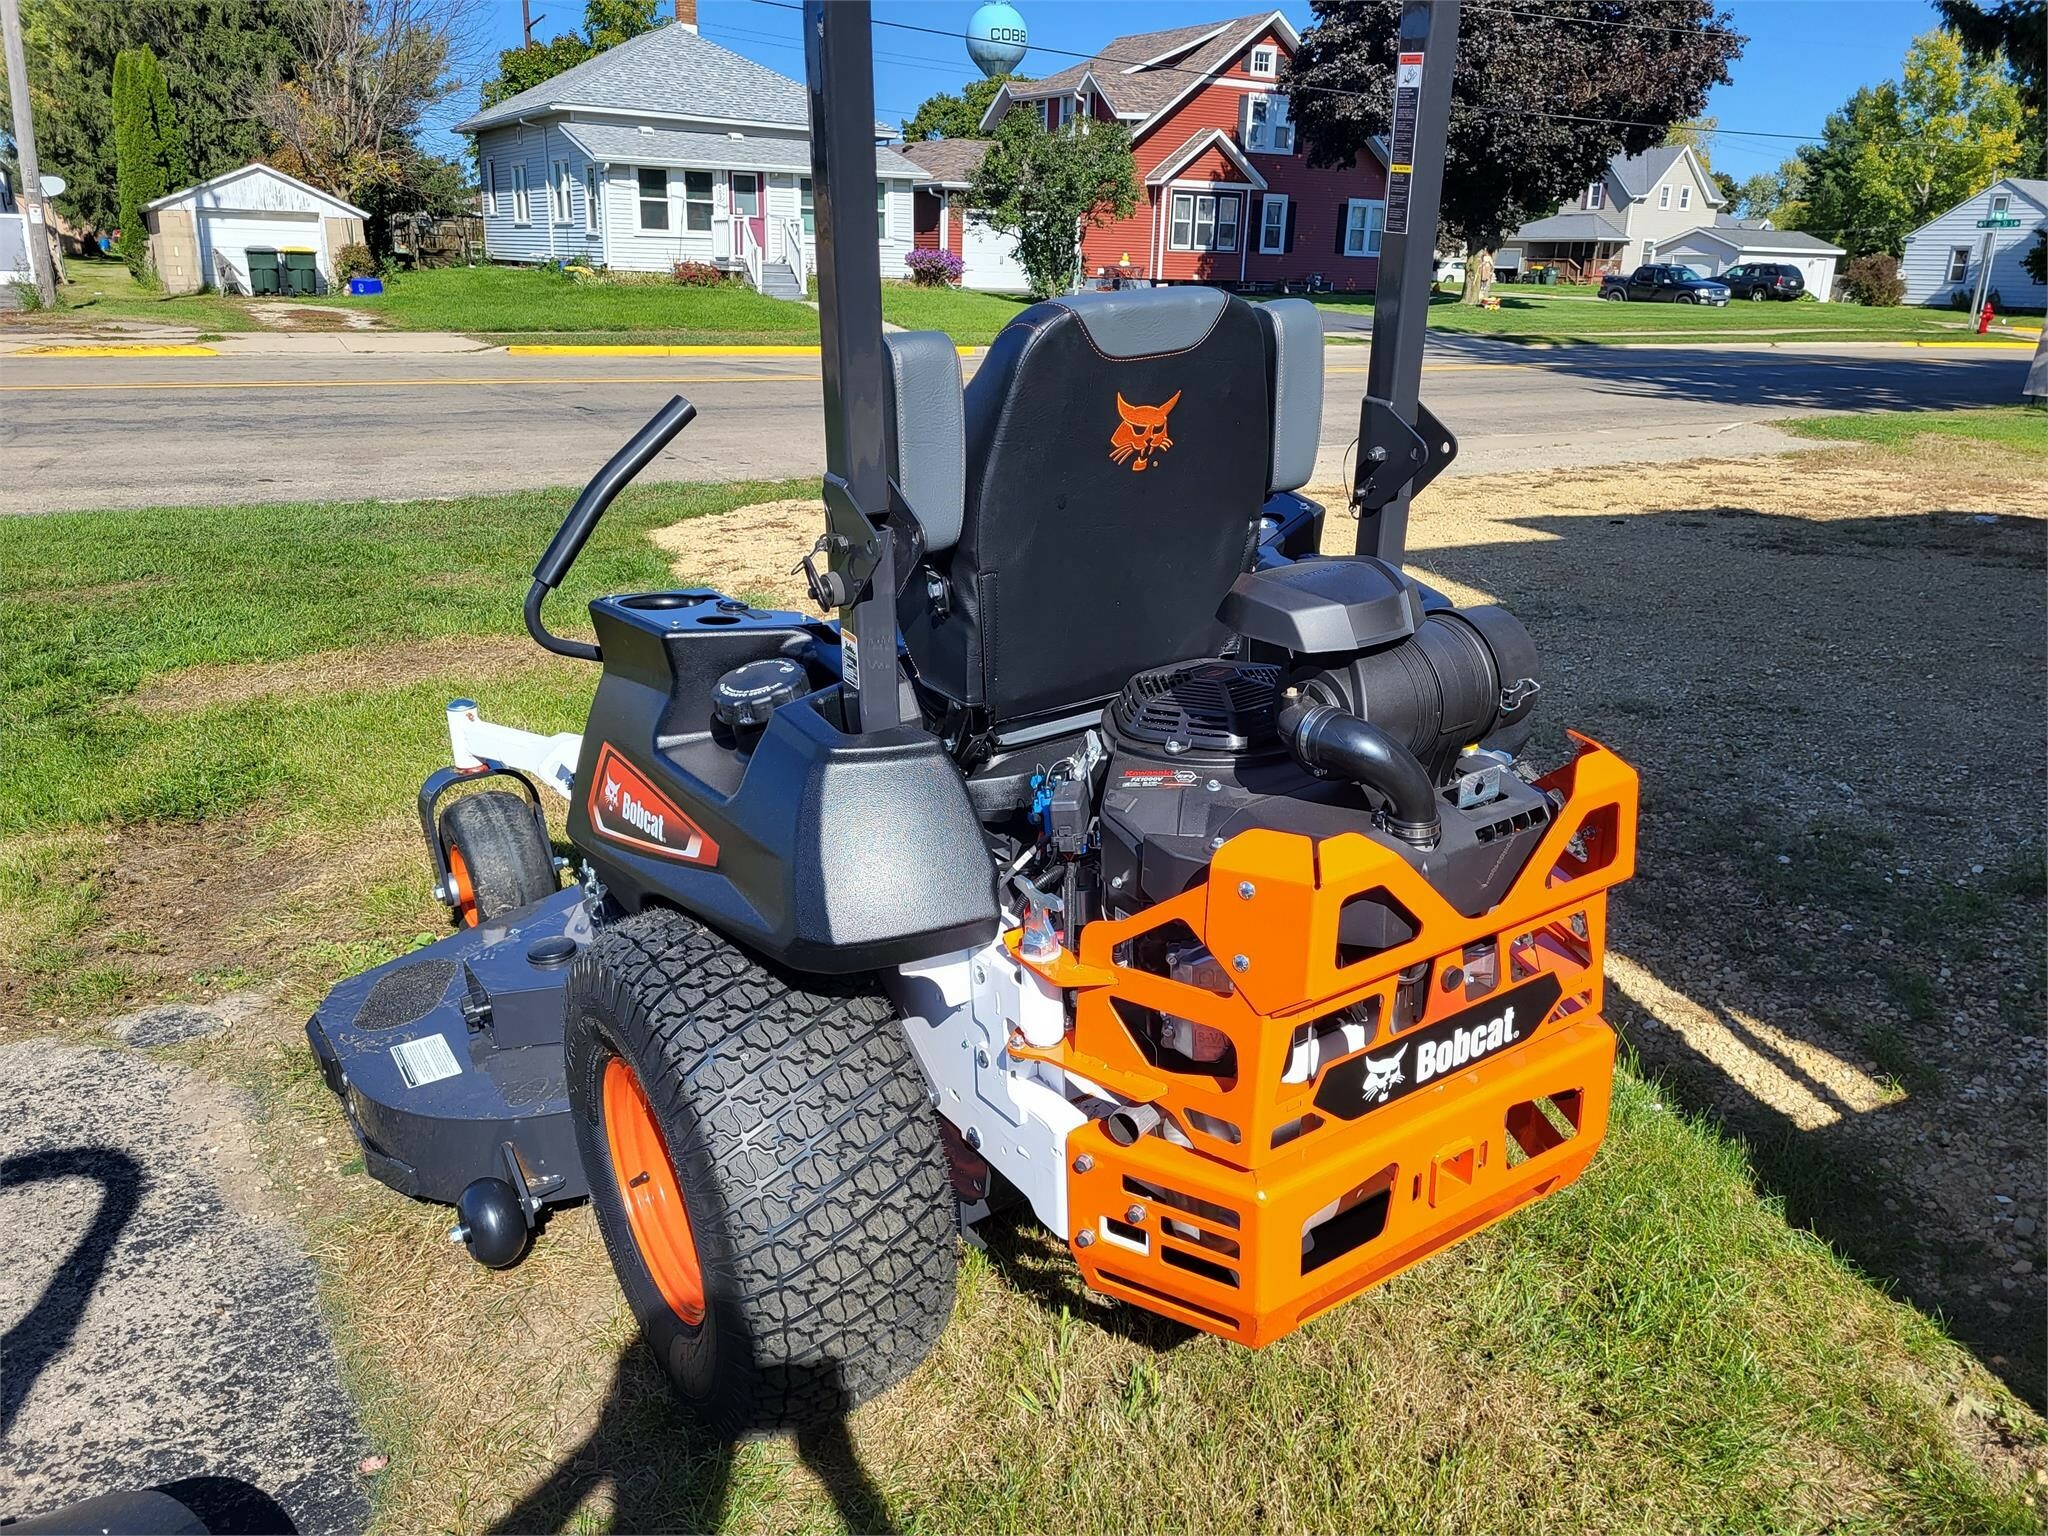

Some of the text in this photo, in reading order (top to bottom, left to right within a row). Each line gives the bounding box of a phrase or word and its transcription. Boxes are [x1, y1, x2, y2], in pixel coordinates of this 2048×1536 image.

[991, 27, 1026, 43] COBB
[1124, 769, 1174, 777] Kawasaki
[622, 791, 664, 842] Bobcat
[1416, 1006, 1515, 1084] Bobcat
